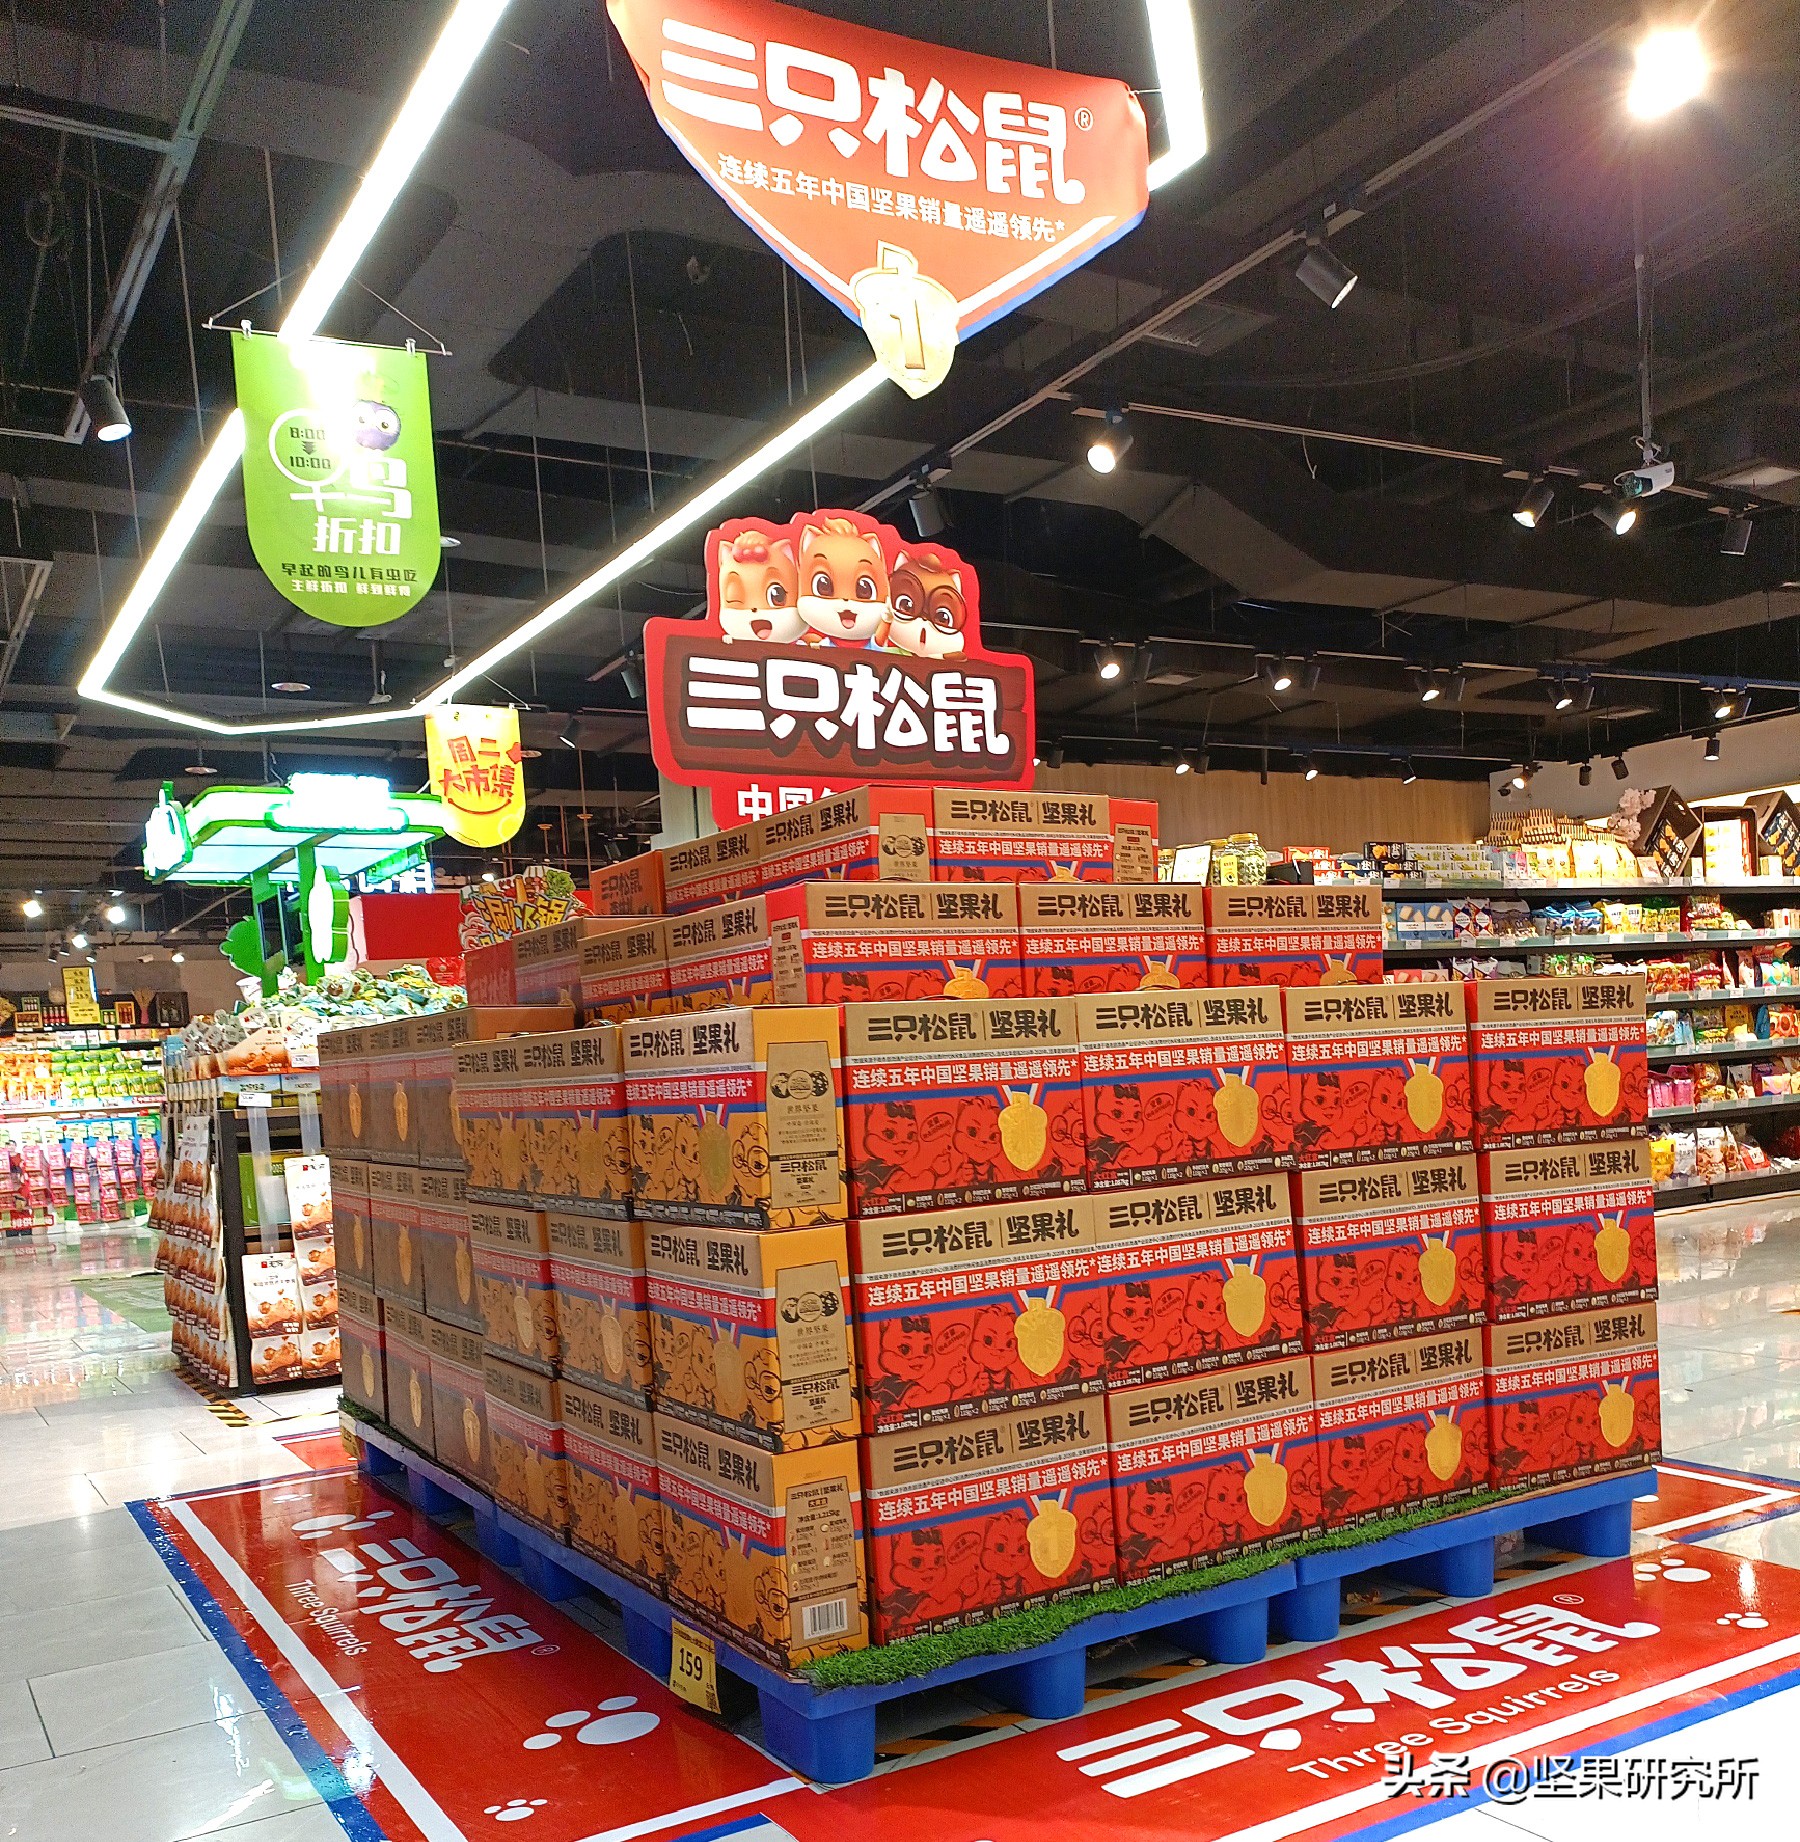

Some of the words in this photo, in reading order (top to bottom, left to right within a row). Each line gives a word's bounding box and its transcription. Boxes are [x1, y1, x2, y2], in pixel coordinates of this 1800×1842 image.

[661, 18, 1086, 204] 三只松鼠
[289, 456, 332, 470] 10:00
[312, 515, 402, 555] 折扣
[281, 562, 418, 582] 早起的鸟儿有虫吃
[687, 656, 1010, 755] 三只松鼠
[447, 735, 501, 763] 周二
[438, 763, 515, 798] 大市集
[737, 783, 840, 823] 中国
[766, 815, 814, 845] 三只松鼠
[820, 798, 859, 832] 坚果礼
[951, 800, 1032, 824] 三只松鼠
[1042, 800, 1097, 826] 坚果礼
[670, 845, 710, 872] 三只松鼠
[716, 833, 749, 862] 坚果礼
[472, 896, 570, 932] 涮火锅
[825, 893, 924, 920] 三只松鼠
[937, 893, 1004, 920] 坚果礼
[1038, 894, 1123, 918] 三只松鼠
[1135, 893, 1192, 918] 坚果礼
[1228, 895, 1308, 918] 三只松鼠
[1316, 895, 1371, 918] 坚果礼
[672, 918, 717, 947] 三只松鼠
[721, 907, 759, 939] 坚果礼
[1096, 1002, 1193, 1030] 三只松鼠
[1203, 997, 1268, 1026] 坚果礼
[1304, 996, 1388, 1022] 三只松鼠
[1399, 991, 1454, 1018] 坚果礼
[1494, 987, 1572, 1012] 三只松鼠
[1581, 984, 1635, 1010] 坚果礼
[630, 1028, 685, 1059] 三只松鼠
[692, 1021, 740, 1056] 坚果礼
[868, 1012, 977, 1042] 三只松鼠
[989, 1008, 1062, 1040] 坚果礼
[780, 1159, 828, 1173] 三只松鼠
[1319, 1175, 1402, 1204] 三只松鼠
[1412, 1166, 1467, 1197] 坚果礼
[1505, 1156, 1580, 1182] 三只松鼠
[1589, 1149, 1640, 1177] 坚果礼
[1109, 1195, 1203, 1229] 三只松鼠
[1213, 1184, 1277, 1218] 坚果礼
[883, 1220, 993, 1258] 三只松鼠
[1006, 1208, 1080, 1246] 坚果礼
[651, 1235, 700, 1267] 三只松鼠
[706, 1240, 749, 1277] 坚果礼
[1507, 1324, 1585, 1355] 三只松鼠
[1594, 1313, 1646, 1343] 坚果礼
[1331, 1353, 1411, 1388] 三只松鼠
[1420, 1339, 1473, 1371] 坚果礼
[791, 1378, 840, 1396] 三只松鼠
[1129, 1388, 1224, 1427] 三只松鼠
[1235, 1370, 1300, 1409] 坚果礼
[565, 1393, 604, 1429] 三只松鼠
[609, 1409, 644, 1446] 坚果礼
[893, 1429, 1004, 1472] 三只松鼠
[1016, 1410, 1090, 1451] 坚果礼
[661, 1429, 712, 1472] 三只松鼠
[718, 1447, 760, 1493] 坚果礼
[285, 1579, 316, 1612] Three
[310, 1605, 372, 1658] Squirrels
[319, 1538, 545, 1673] 三只松鼠
[679, 1647, 703, 1682] 159
[1056, 1612, 1661, 1799] 三只松鼠
[1287, 1733, 1433, 1780] Three
[1427, 1666, 1621, 1736] Squirrels
